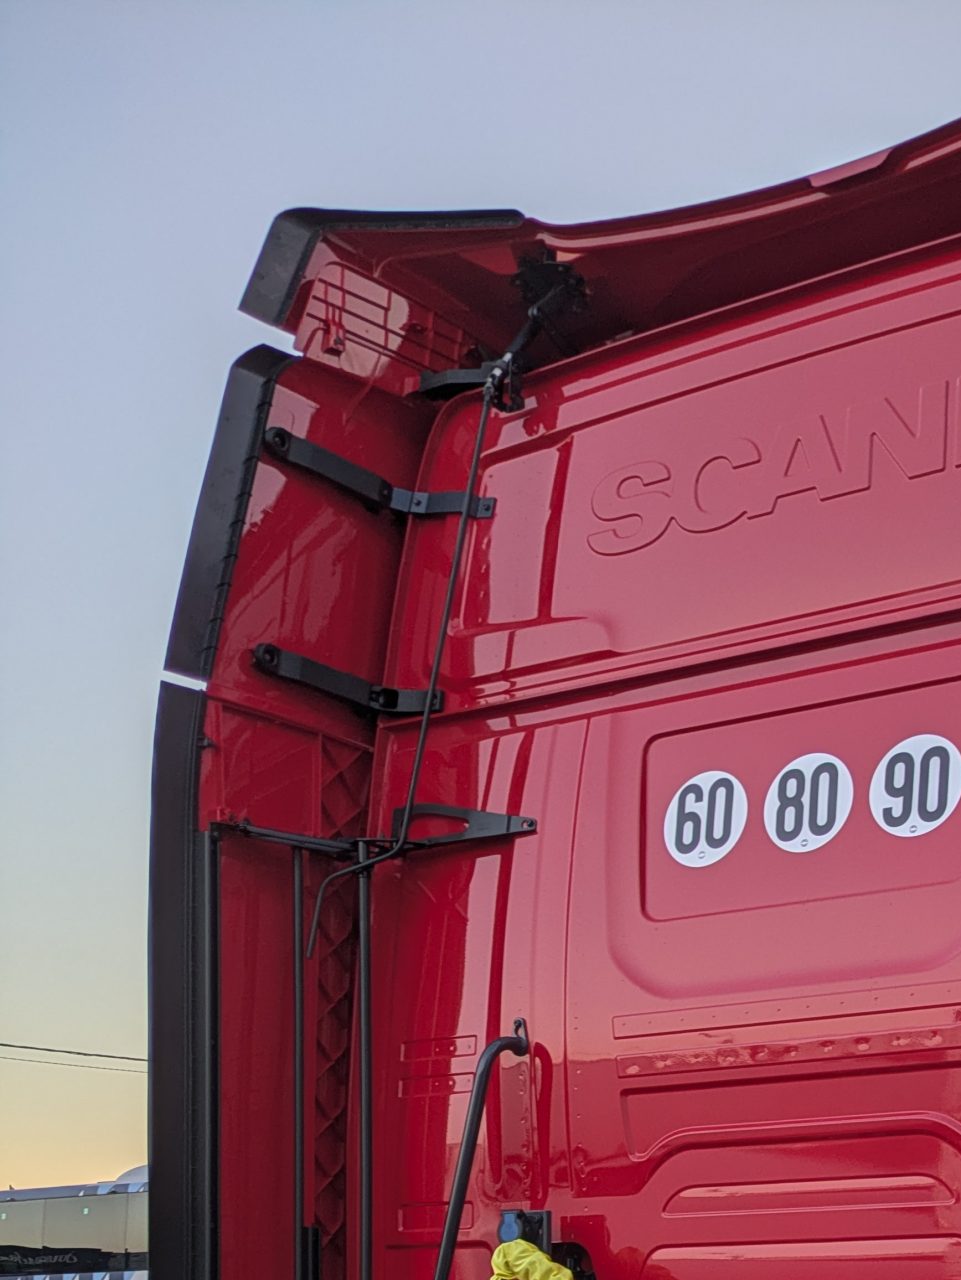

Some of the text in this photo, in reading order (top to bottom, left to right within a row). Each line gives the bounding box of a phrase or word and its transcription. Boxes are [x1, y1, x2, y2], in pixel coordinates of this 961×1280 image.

[673, 745, 950, 855] 60 80 90
